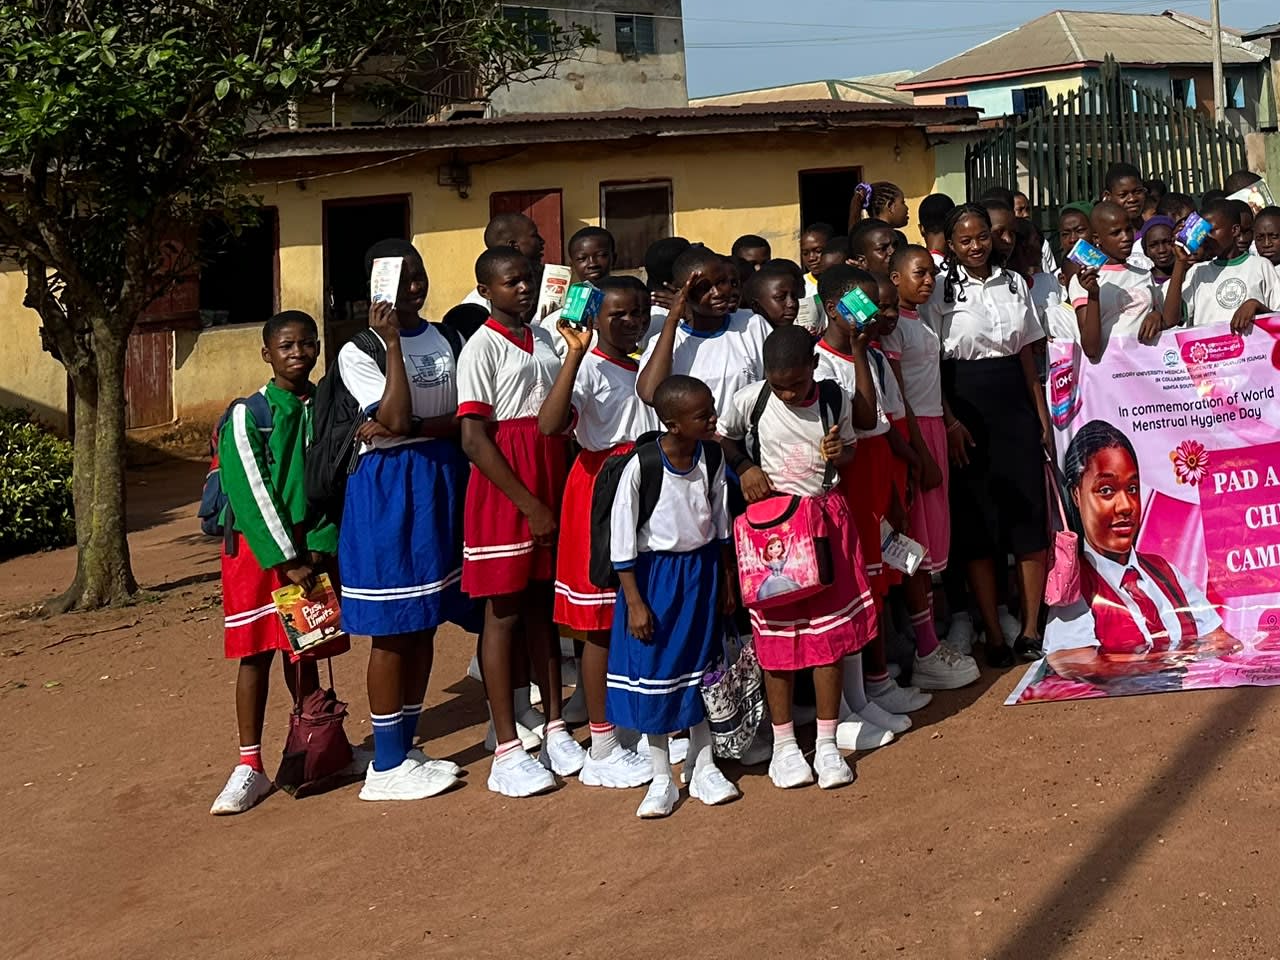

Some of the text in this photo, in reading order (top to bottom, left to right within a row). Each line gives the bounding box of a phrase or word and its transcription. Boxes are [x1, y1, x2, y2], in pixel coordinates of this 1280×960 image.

[1118, 386, 1275, 418] In commemoration of World
[1132, 406, 1262, 432] Menstrual Hygiene Day
[1212, 469, 1259, 494] PAD
[1264, 466, 1280, 487] A
[307, 608, 335, 629] Limits
